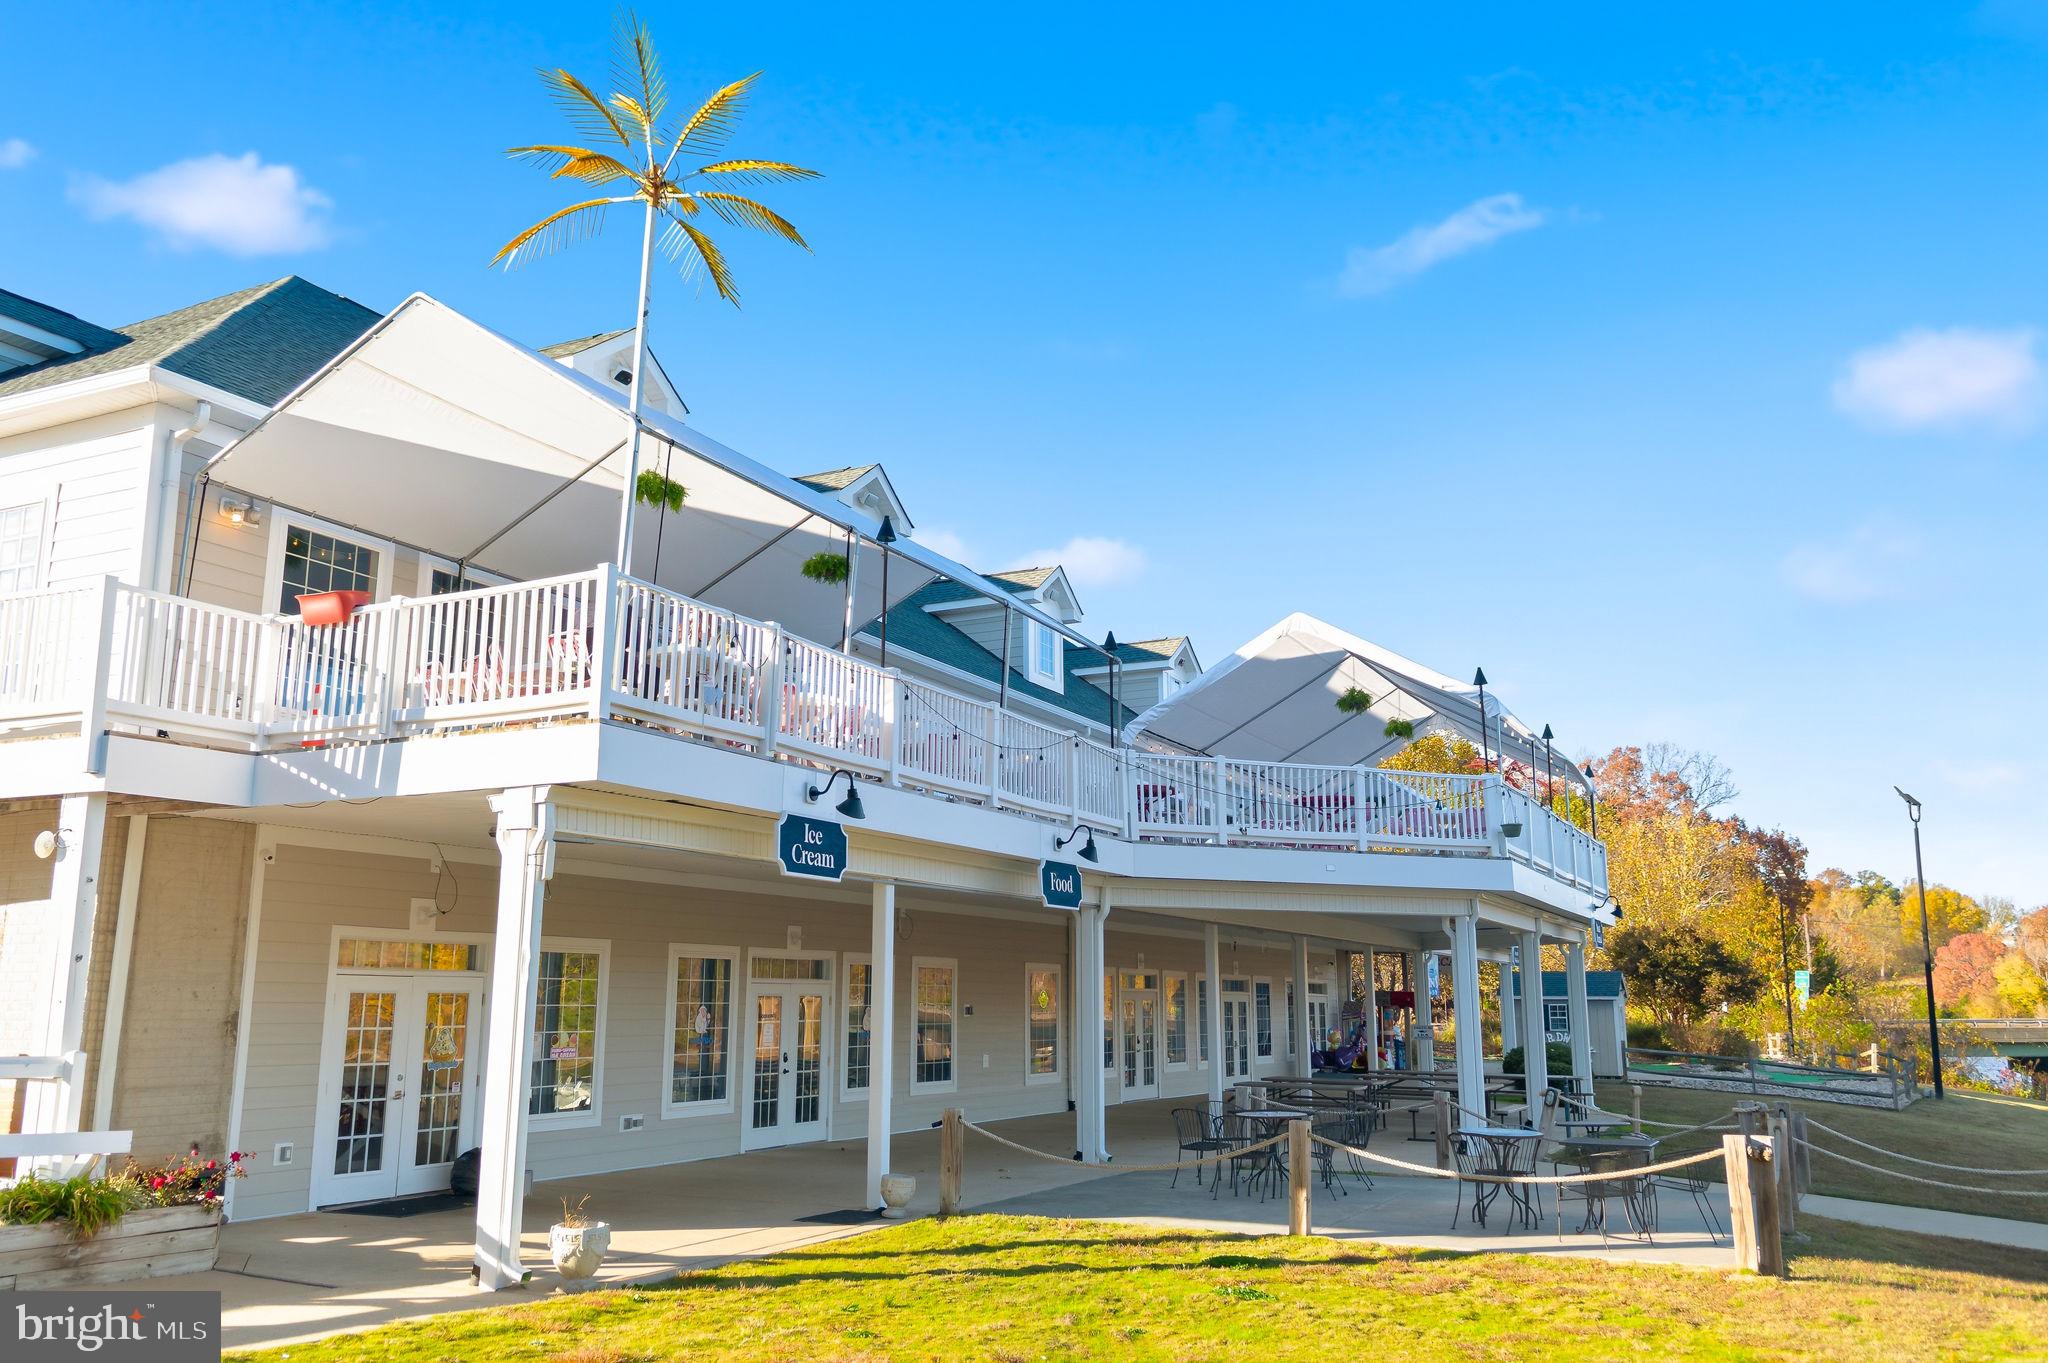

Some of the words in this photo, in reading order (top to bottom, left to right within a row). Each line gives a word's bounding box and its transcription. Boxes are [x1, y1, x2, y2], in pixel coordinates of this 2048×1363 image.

[804, 823, 823, 845] Ice
[791, 843, 835, 869] Cream
[1050, 872, 1073, 893] Food
